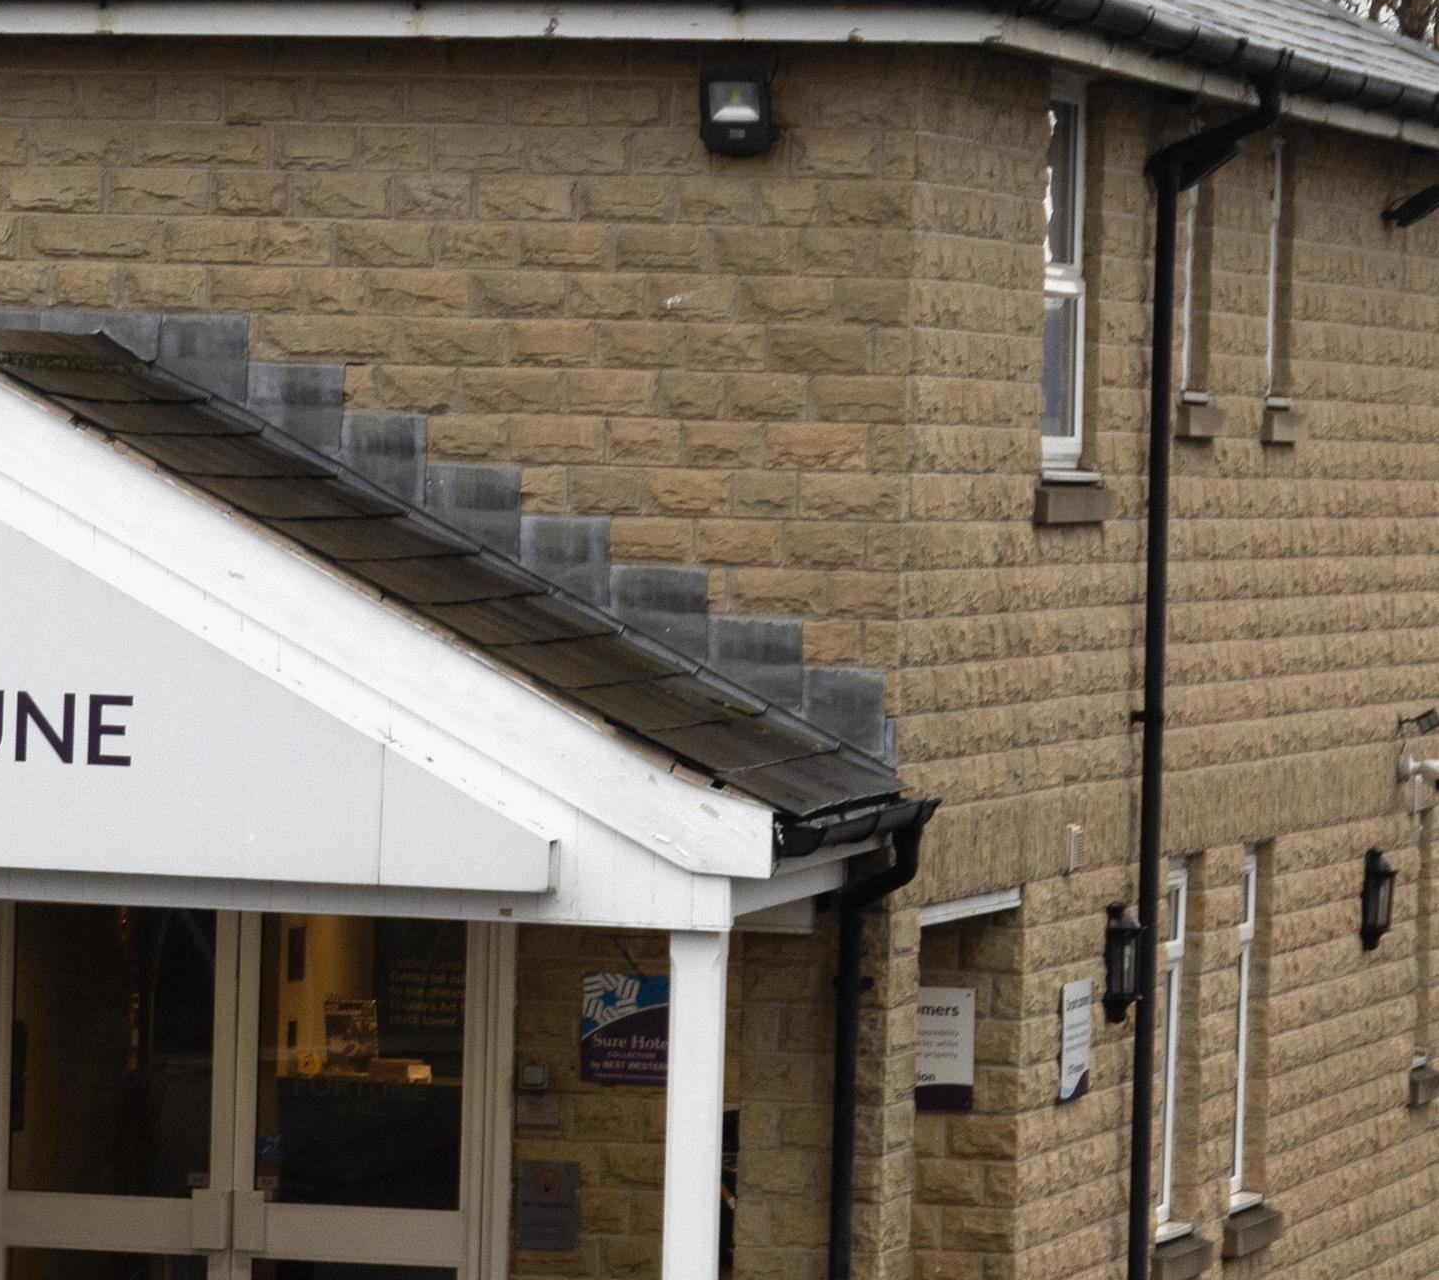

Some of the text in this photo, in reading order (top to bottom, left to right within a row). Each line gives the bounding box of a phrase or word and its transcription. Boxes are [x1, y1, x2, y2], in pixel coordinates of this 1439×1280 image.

[917, 1005, 960, 1017] mers
[593, 1033, 668, 1050] Sure Hote
[602, 1060, 626, 1070] BEST
